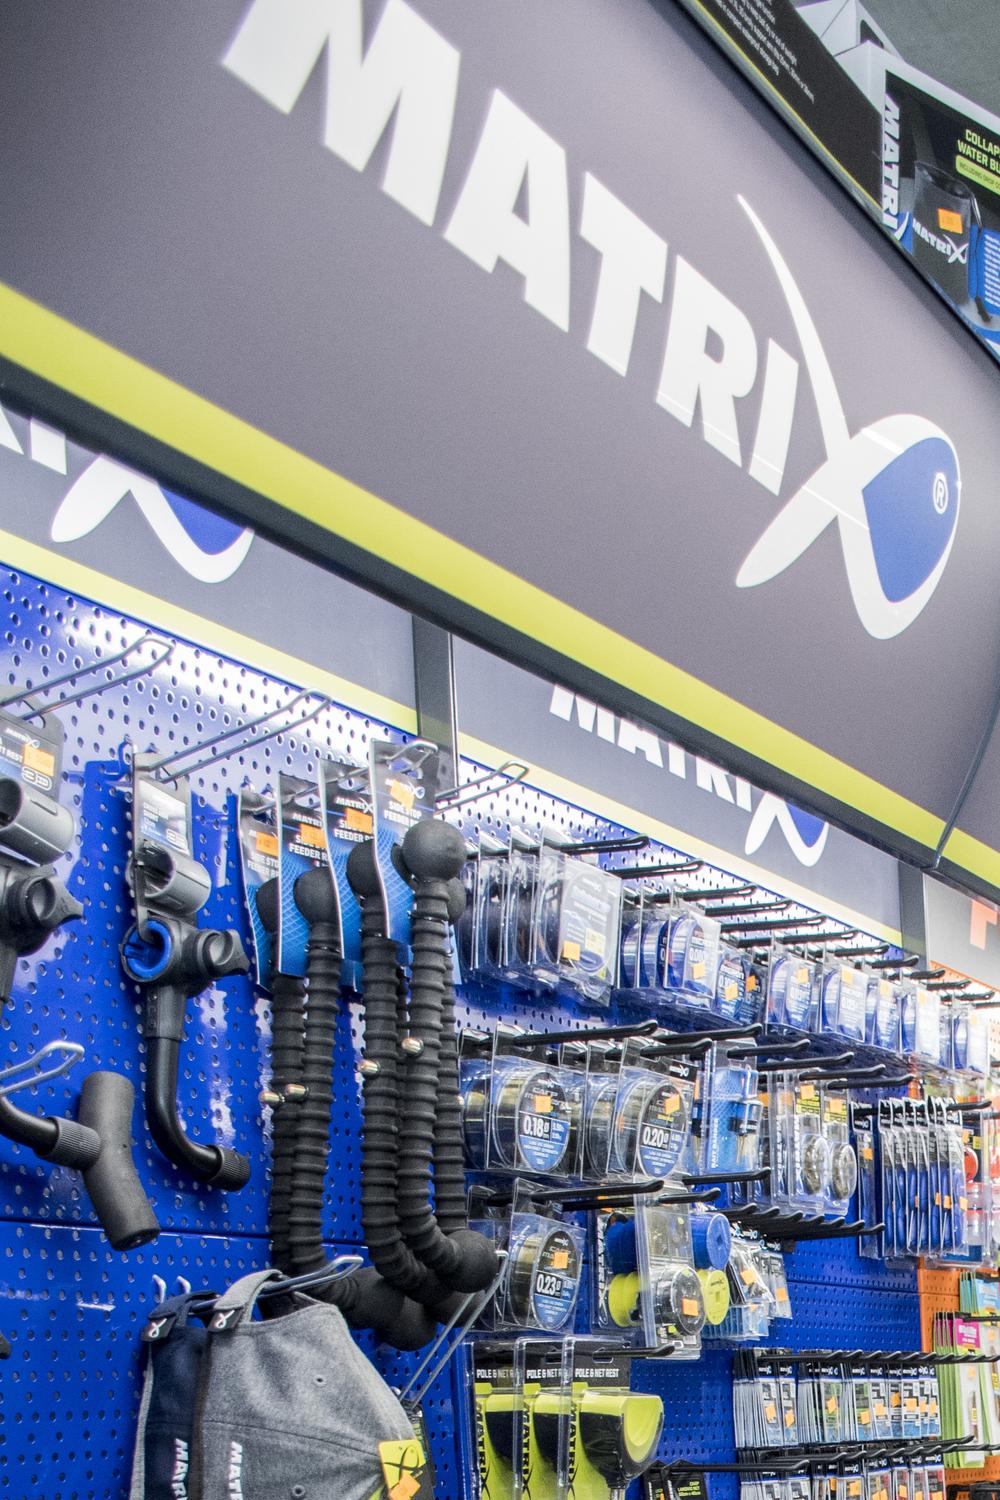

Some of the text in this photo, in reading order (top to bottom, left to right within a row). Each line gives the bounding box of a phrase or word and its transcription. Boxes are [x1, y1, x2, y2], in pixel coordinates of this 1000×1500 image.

[957, 139, 989, 168] WATER
[882, 92, 909, 241] MATRI
[912, 218, 969, 264] MATRIX
[221, 0, 961, 640] MATRIX
[292, 812, 324, 828] MATRI
[333, 828, 364, 844] FEEDER
[288, 842, 321, 860] FEEDER
[476, 1368, 492, 1379] POLE
[497, 1369, 510, 1379] NET
[526, 1368, 542, 1379] POLE
[549, 1369, 559, 1378] NET
[575, 1368, 590, 1378] POLE
[595, 1368, 606, 1378] NET
[605, 1368, 620, 1378] REST
